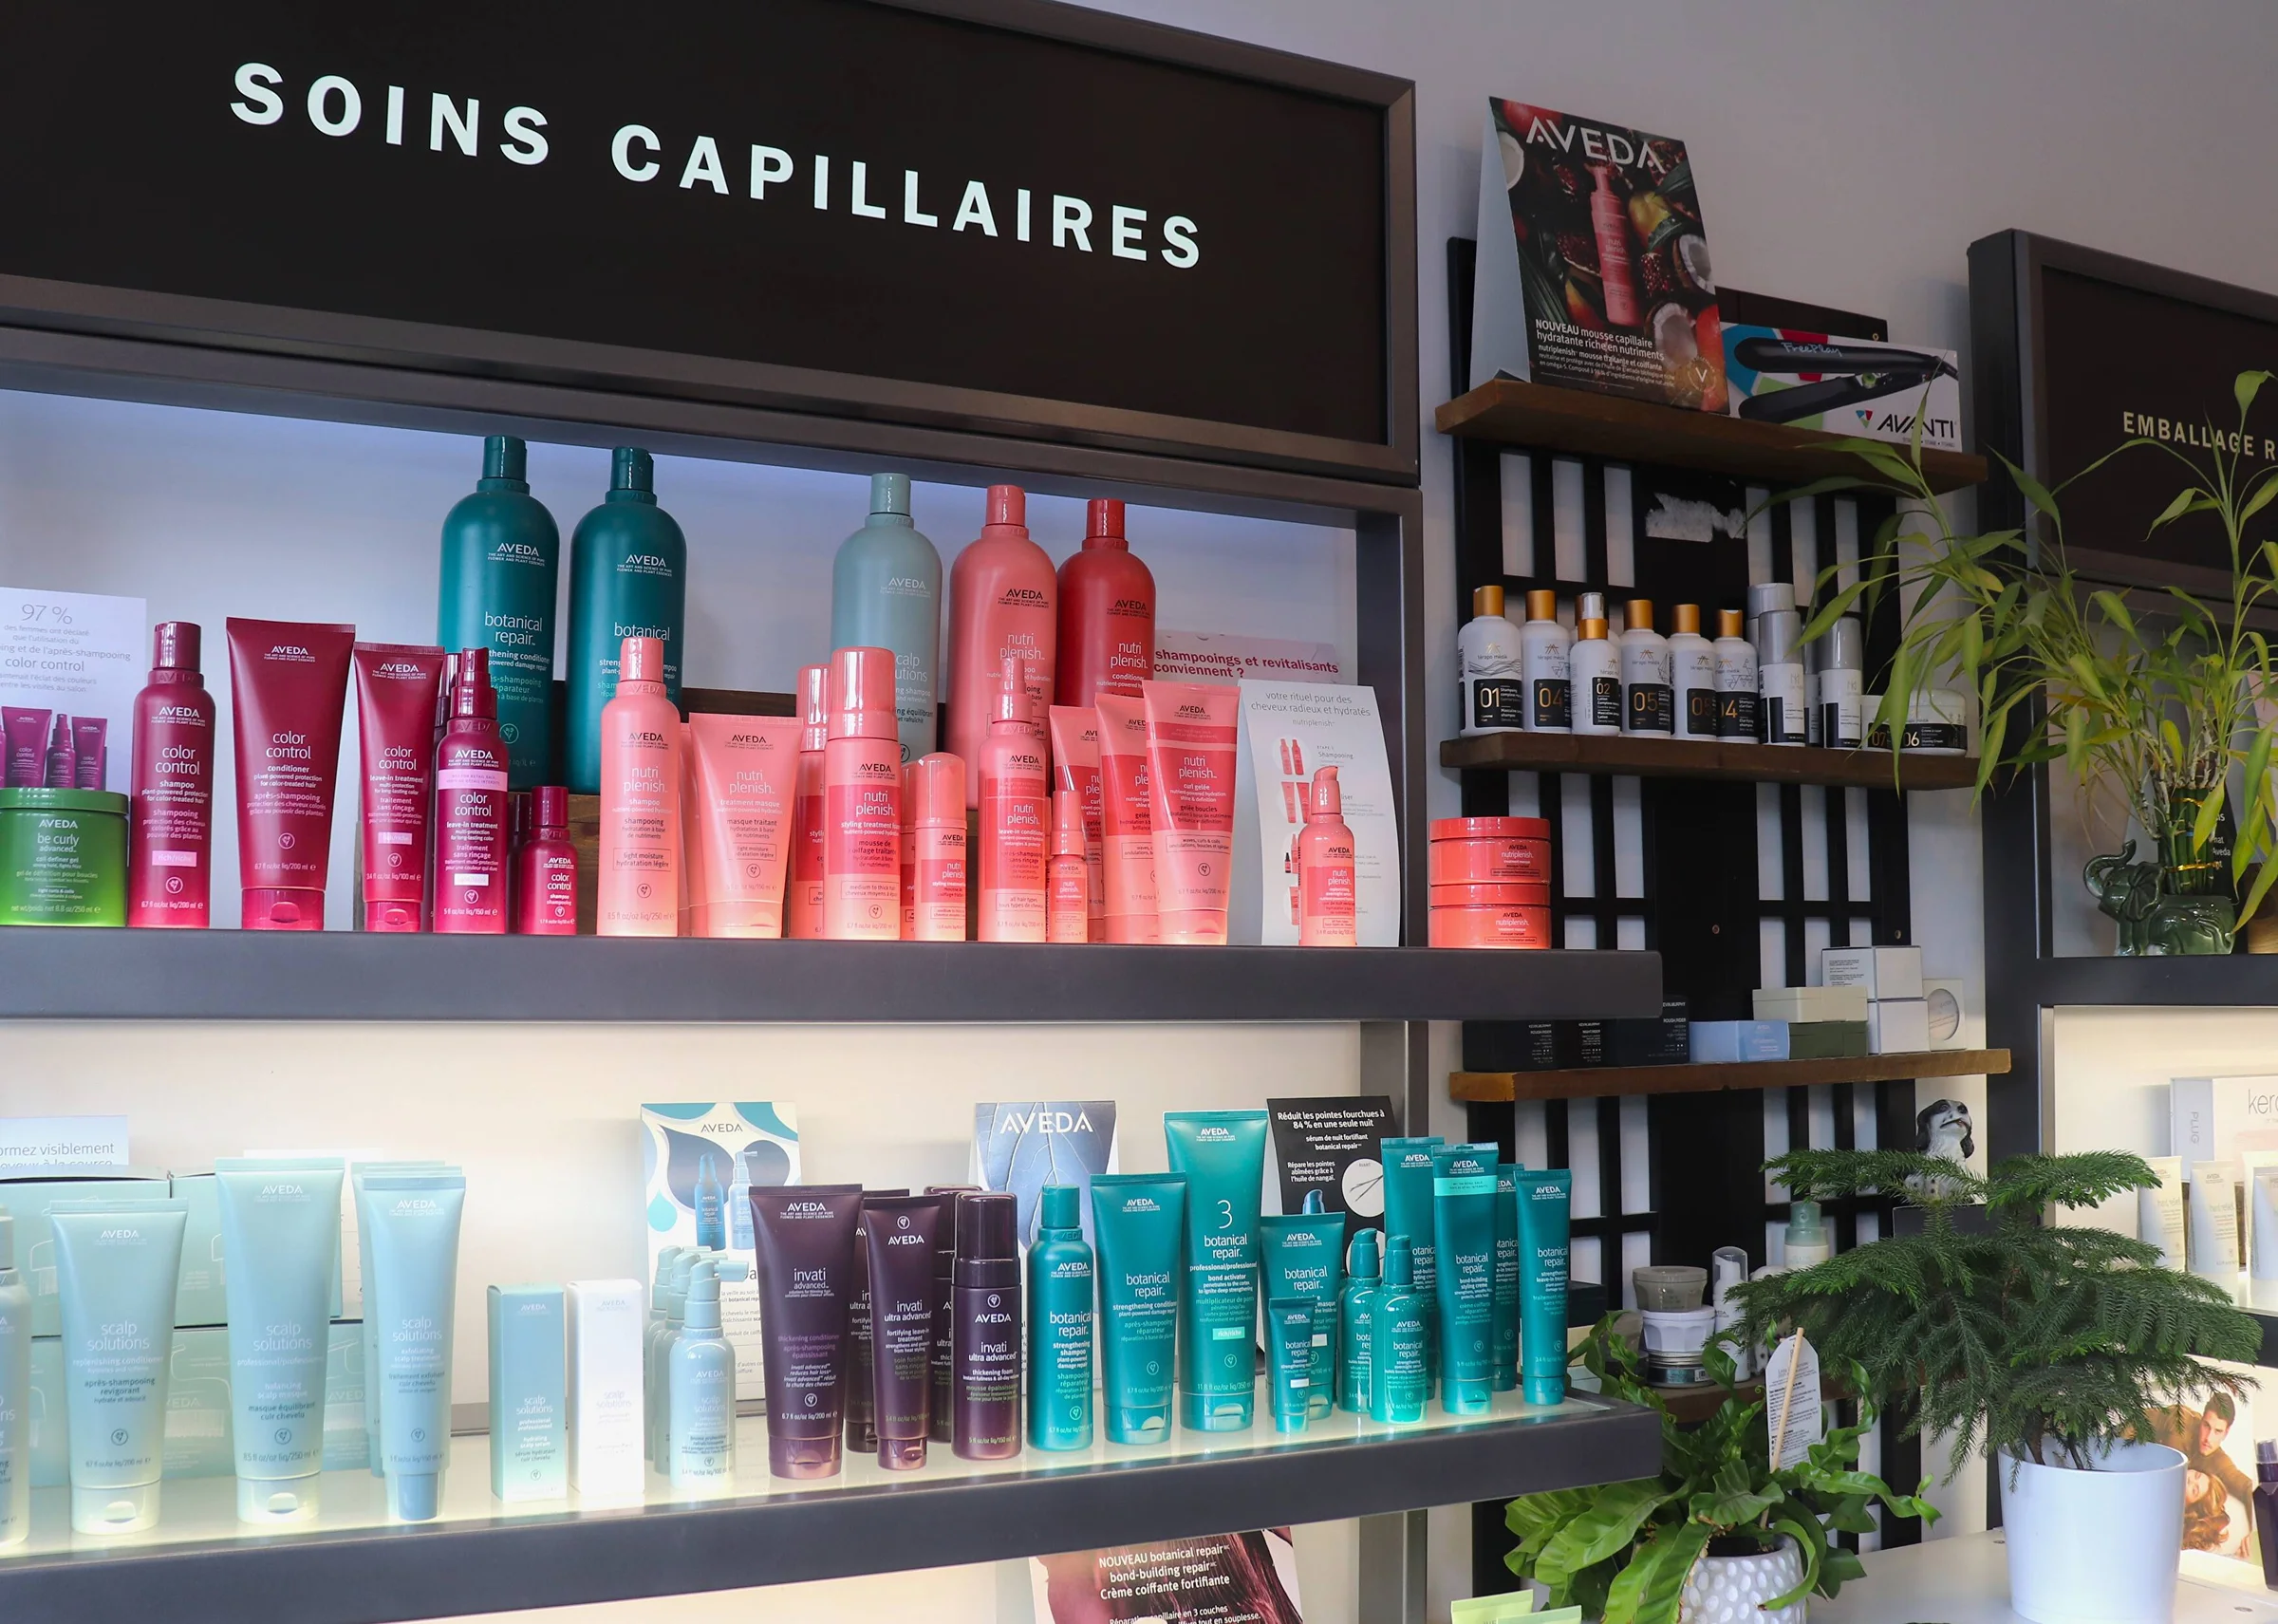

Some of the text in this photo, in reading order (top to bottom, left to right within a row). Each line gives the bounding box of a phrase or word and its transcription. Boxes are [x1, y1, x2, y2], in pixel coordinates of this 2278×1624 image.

[1526, 116, 1666, 174] AVEDA
[230, 62, 1200, 269] SOINS CAPILLAIRES
[1536, 319, 1652, 348] NOUVEAU mousse capillaire
[1537, 330, 1583, 347] hydratante
[1585, 340, 1606, 350] riche
[1619, 345, 1664, 361] nutriments
[1782, 342, 1843, 357] FreePlay
[1877, 414, 1954, 439] AVANTI
[2123, 411, 2254, 456] EMBALLAGE
[497, 543, 539, 556] AVEDA
[626, 554, 666, 567] AVEDA
[888, 577, 925, 589] AVEDA
[1006, 588, 1042, 600] AVEDA
[1115, 600, 1146, 610] AVEDA
[23, 604, 72, 625] 97 %
[485, 612, 542, 632] botanical
[615, 623, 670, 641] botanical
[1008, 633, 1034, 644] nutri
[271, 645, 308, 655] AVEDA
[1119, 642, 1141, 654] nutri
[6, 657, 84, 672] color control
[897, 653, 920, 668] calp
[1156, 649, 1338, 674] shampooings et revitalisants
[381, 663, 419, 672] AVEDA
[1154, 664, 1244, 678] conviennent ?
[1596, 683, 1610, 694] 02
[1266, 692, 1352, 704] votre rituel pour des
[1481, 688, 1500, 707] 01
[1540, 688, 1562, 707] 04
[1634, 692, 1657, 712] 05
[159, 707, 199, 718] AVEDA
[1180, 705, 1204, 714] AVEDA
[1251, 702, 1287, 711] cheveux
[1289, 704, 1321, 714] radieux
[1334, 707, 1370, 717] hydratés
[273, 731, 306, 744] color
[628, 733, 663, 742] AVEDA
[732, 735, 766, 743] AVEDA
[162, 745, 195, 759] color
[266, 745, 310, 759] control
[384, 747, 412, 758] color
[456, 750, 493, 759] AVEDA
[1318, 751, 1353, 759] Shampooing
[379, 758, 416, 771] control
[1010, 756, 1039, 764] AVEDA
[1185, 756, 1205, 766] nutri
[156, 761, 200, 775] control
[268, 764, 309, 773] conditioner
[632, 767, 658, 778] nutri
[859, 764, 891, 773] AVEDA
[737, 770, 762, 780] nutri
[159, 780, 195, 790] shampoo
[254, 792, 320, 803] après-shampooing
[460, 793, 488, 804] color
[865, 791, 887, 802] nutri
[154, 810, 197, 818] shampooing
[455, 805, 492, 816] control
[1014, 804, 1033, 813] nutri
[39, 820, 78, 829] AVEDA
[753, 818, 776, 827] traitant
[38, 833, 79, 847] be curly
[551, 873, 569, 882] color
[548, 882, 571, 890] control
[1278, 1111, 1302, 1120] Réduit
[1303, 1111, 1314, 1120] les
[1316, 1111, 1342, 1120] pointes
[1343, 1110, 1379, 1118] fourchues
[999, 1111, 1092, 1133] AVEDA
[1339, 1119, 1358, 1128] seule
[701, 1124, 743, 1132] AVEDA
[1201, 1128, 1228, 1136] AVEDA
[2190, 1111, 2200, 1145] PLUG
[39, 1143, 114, 1155] visiblement
[1405, 1154, 1429, 1163] AVEDA
[1452, 1160, 1478, 1168] AVEDA
[263, 1185, 303, 1194] AVEDA
[1536, 1186, 1560, 1195] AVEDA
[397, 1200, 436, 1209] AVEDA
[788, 1203, 826, 1211] AVEDA
[1217, 1199, 1232, 1229] 3
[888, 1235, 924, 1245] AVEDA
[1204, 1233, 1247, 1247] botanical
[1287, 1233, 1315, 1241] AVEDA
[1538, 1246, 1568, 1258] botanical
[1456, 1253, 1488, 1264] botanical
[1057, 1262, 1088, 1271] AVEDA
[794, 1267, 826, 1281] invati
[1126, 1271, 1169, 1285] botanical
[1284, 1267, 1328, 1280] botanical
[897, 1299, 923, 1313] invati
[1113, 1302, 1153, 1311] strengthening
[885, 1314, 900, 1322] ultra
[975, 1314, 1011, 1323] AVEDA
[1050, 1311, 1092, 1324] botanical
[102, 1321, 137, 1336] scalp
[402, 1317, 431, 1330] scalp
[266, 1324, 300, 1336] scalp
[393, 1330, 442, 1341] solutions
[87, 1336, 149, 1351] solutions
[253, 1337, 312, 1351] solutions
[981, 1341, 1007, 1353] invati
[1285, 1340, 1312, 1350] botanical
[1392, 1341, 1423, 1352] botanical
[969, 1353, 984, 1361] ultra
[84, 1378, 155, 1387] après-shampooing
[101, 1387, 140, 1395] revigorant
[524, 1395, 546, 1406] scalp
[249, 1404, 275, 1413] masque
[516, 1406, 552, 1414] solutions
[277, 1411, 305, 1420] chevelu
[1099, 1553, 1148, 1568] NOUVEAU
[1150, 1547, 1194, 1562] botanical
[1110, 1567, 1181, 1583] bond-building
[1100, 1575, 1230, 1600] Crème coiffante fortifiante
[1200, 1605, 1228, 1615] couches
[1224, 1612, 1260, 1624] souplesse.
